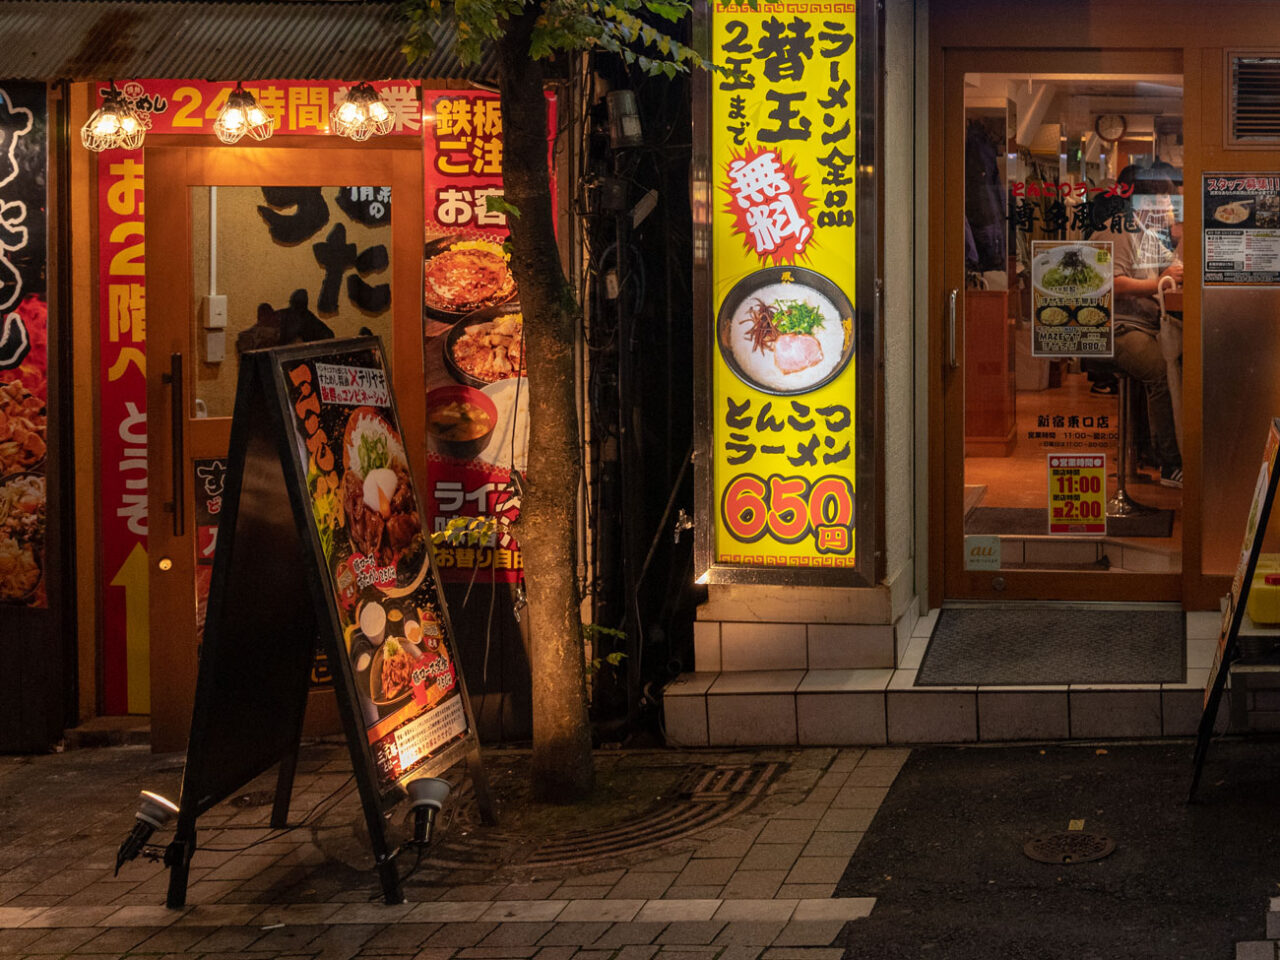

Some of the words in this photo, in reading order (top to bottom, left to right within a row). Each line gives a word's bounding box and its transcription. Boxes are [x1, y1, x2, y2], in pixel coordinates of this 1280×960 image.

[752, 16, 815, 142] 替玉
[816, 21, 855, 228] ラーメン全品
[1011, 181, 1135, 198] とんこつラーメン
[725, 397, 851, 433] とんこつ
[1037, 415, 1110, 429] 新宿東口店
[724, 432, 851, 468] ラーメン
[1057, 476, 1101, 494] 11:00
[970, 545, 995, 557] au
